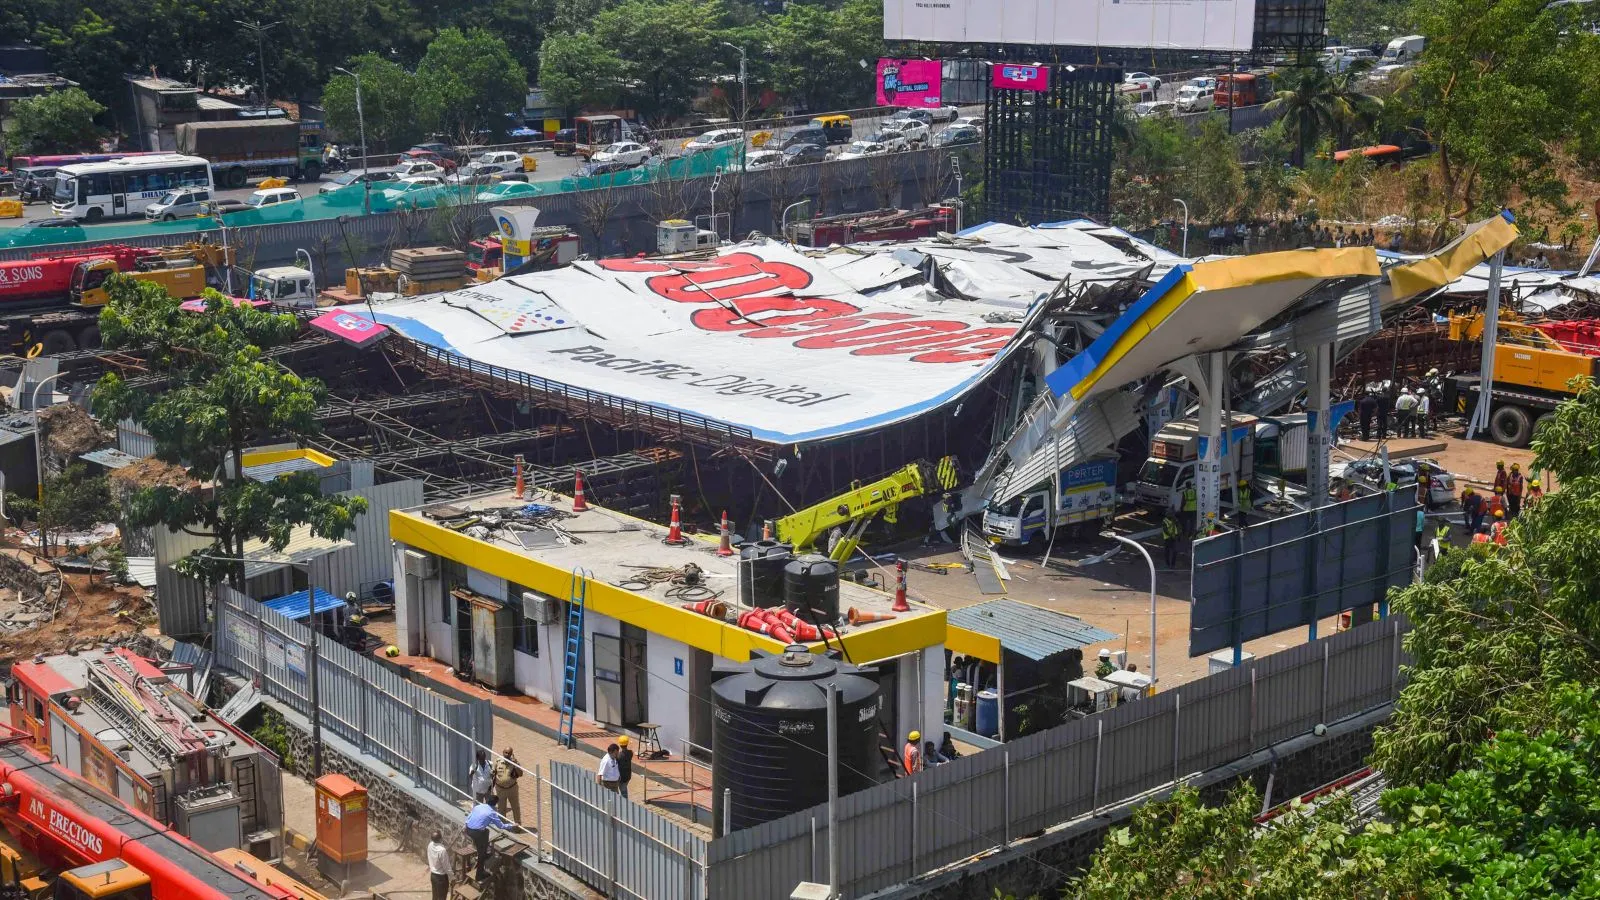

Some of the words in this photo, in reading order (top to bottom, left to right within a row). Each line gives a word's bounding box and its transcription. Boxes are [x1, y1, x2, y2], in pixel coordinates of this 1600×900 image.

[11, 265, 43, 281] SONS
[547, 344, 705, 381] Pacific
[685, 374, 851, 408] Digital
[1068, 464, 1104, 481] PORTER
[881, 486, 897, 501] ACE
[49, 808, 103, 854] ERECTORS
